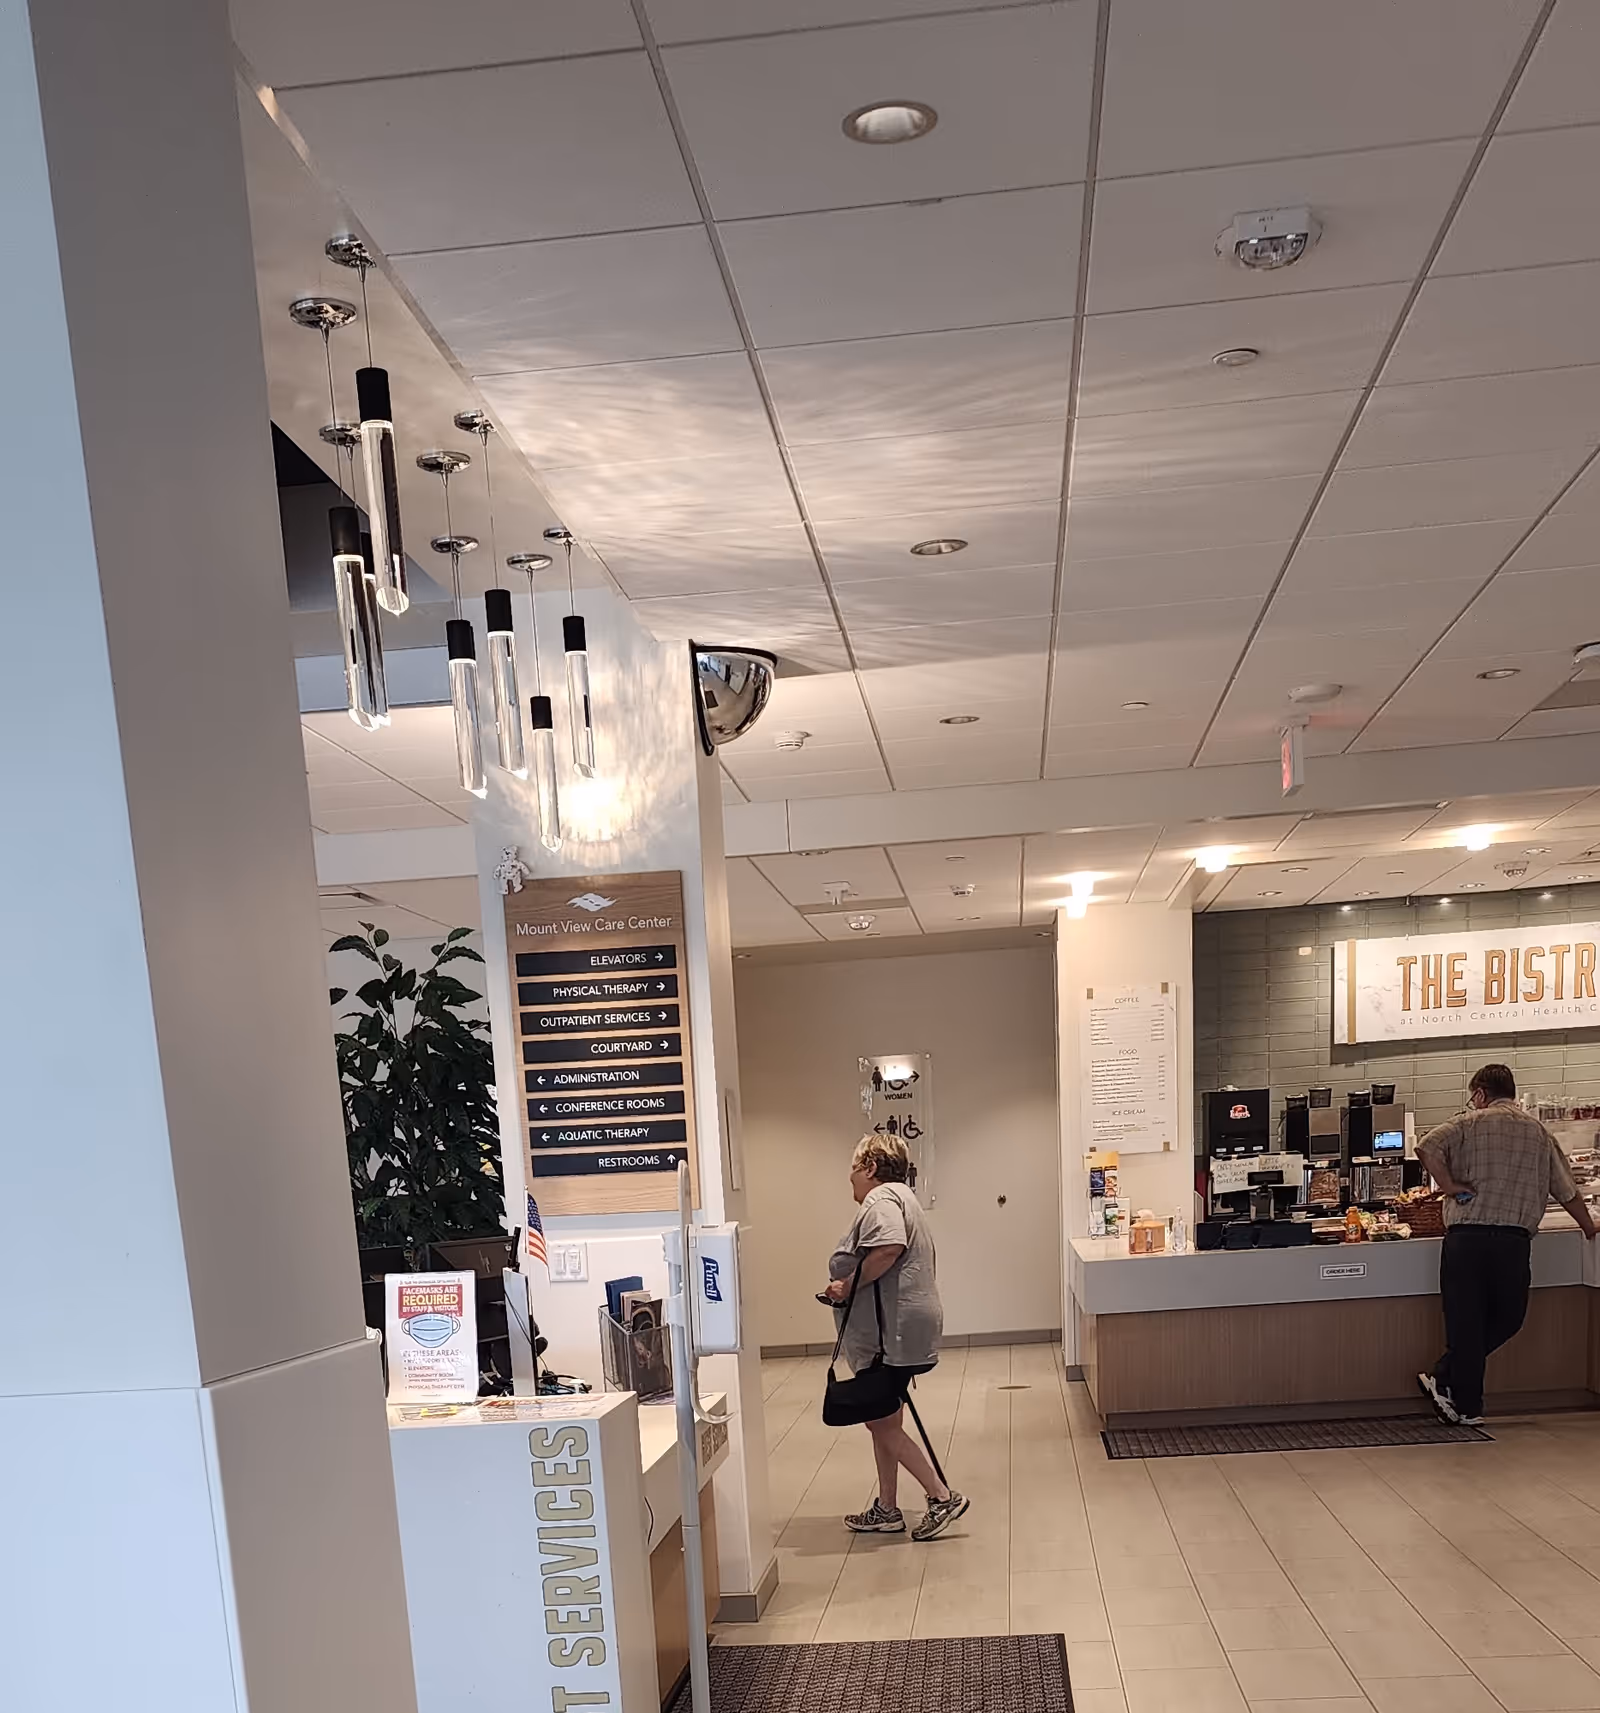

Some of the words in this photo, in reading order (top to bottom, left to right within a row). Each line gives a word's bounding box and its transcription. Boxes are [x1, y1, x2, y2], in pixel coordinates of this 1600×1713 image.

[516, 923, 558, 936] Mount
[561, 920, 591, 933] View
[595, 918, 625, 931] Care
[628, 916, 672, 929] Center
[590, 953, 647, 966] ELEVATORS
[1397, 952, 1467, 1011] THE
[553, 985, 601, 998] PHYSICAL
[603, 982, 649, 994] THERAPY
[540, 1014, 602, 1027] OUTPATIENT
[604, 1012, 650, 1024] SERVICES
[1400, 1017, 1413, 1025] at
[1422, 1013, 1462, 1024] North
[1470, 1009, 1524, 1020] Central
[1533, 1005, 1581, 1016] Health
[590, 1041, 652, 1053] COURTYARD
[554, 1071, 640, 1084] ADMINISTRATION
[884, 1092, 913, 1101] WOMEN
[555, 1100, 624, 1113] CONFERENCE
[626, 1098, 665, 1109] ROOMS
[558, 1129, 602, 1141] AQUATIC
[604, 1128, 650, 1139] THERAPY
[598, 1155, 660, 1168] RESTROOMS
[705, 1262, 717, 1297] Purell
[402, 1286, 443, 1295] FACEMASKS
[402, 1294, 459, 1306] REQUIRED
[528, 1425, 607, 1668] SERVICES
